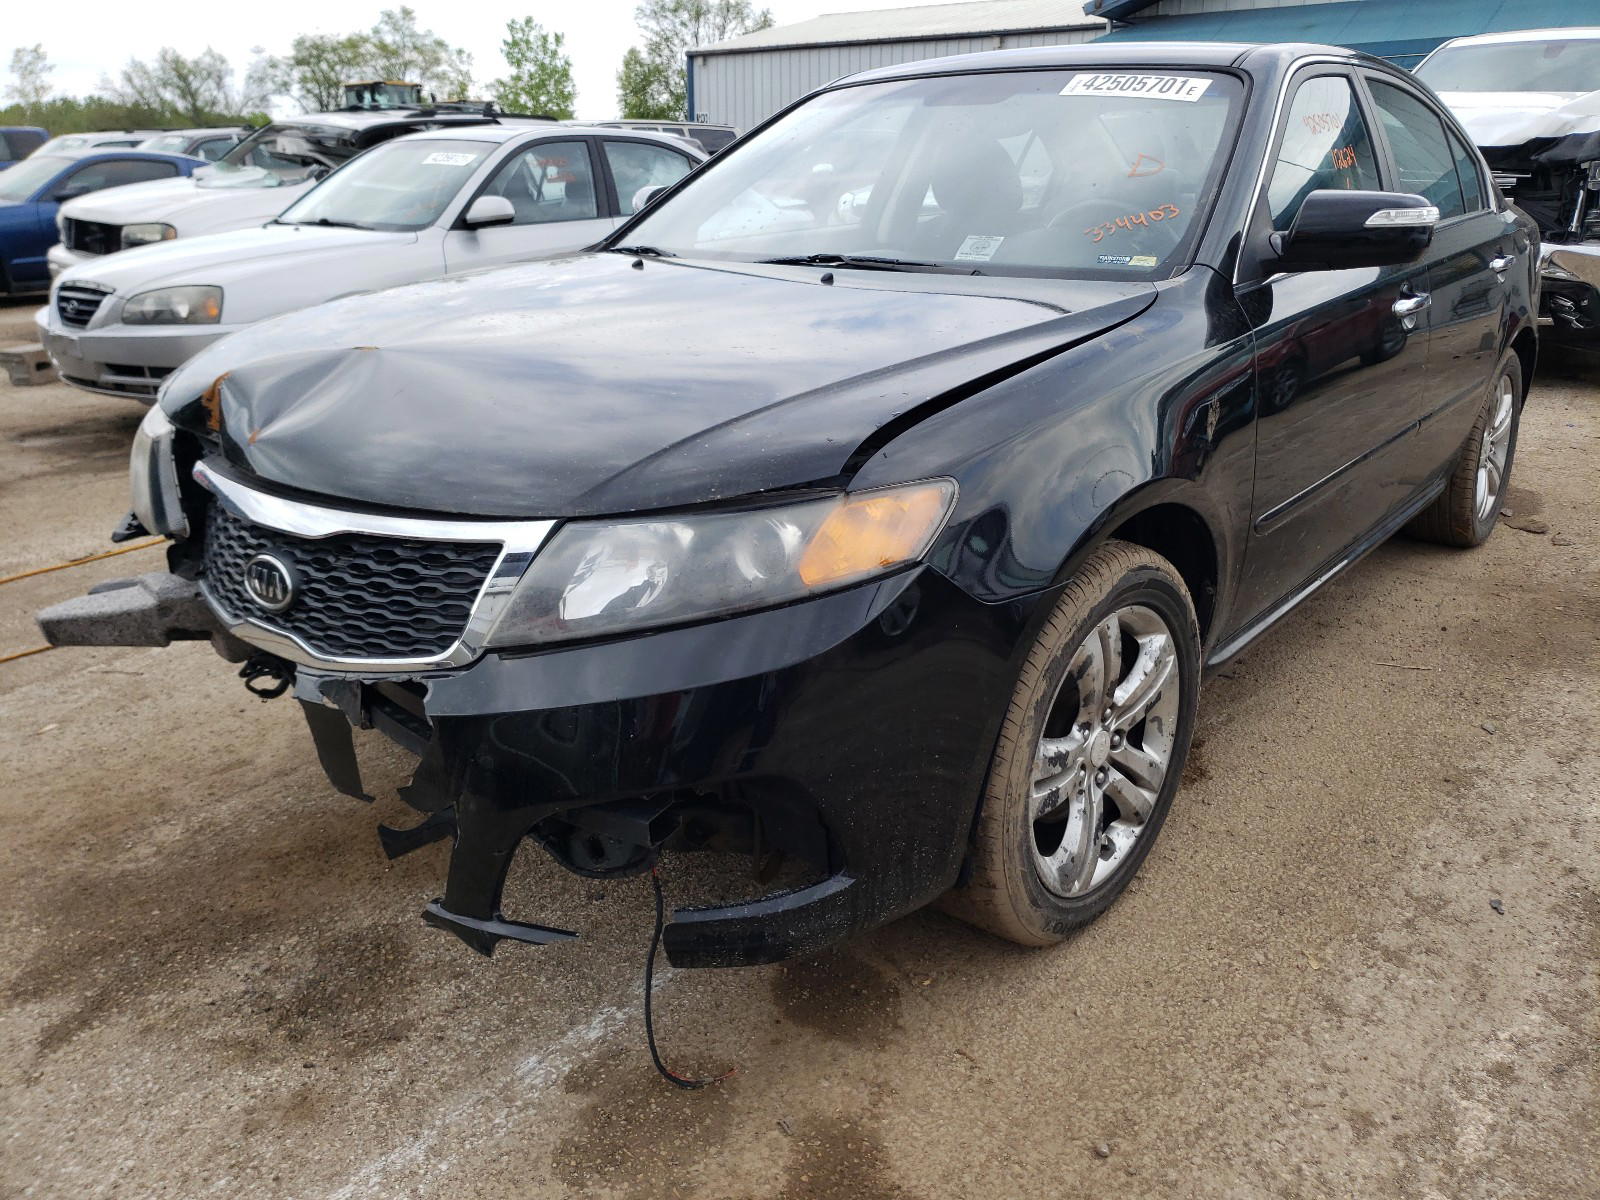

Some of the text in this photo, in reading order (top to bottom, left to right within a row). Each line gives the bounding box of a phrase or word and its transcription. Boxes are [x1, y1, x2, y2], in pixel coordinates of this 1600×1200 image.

[1082, 75, 1190, 95] 42505701
[1186, 86, 1199, 96] E
[1083, 203, 1181, 244] 334403
